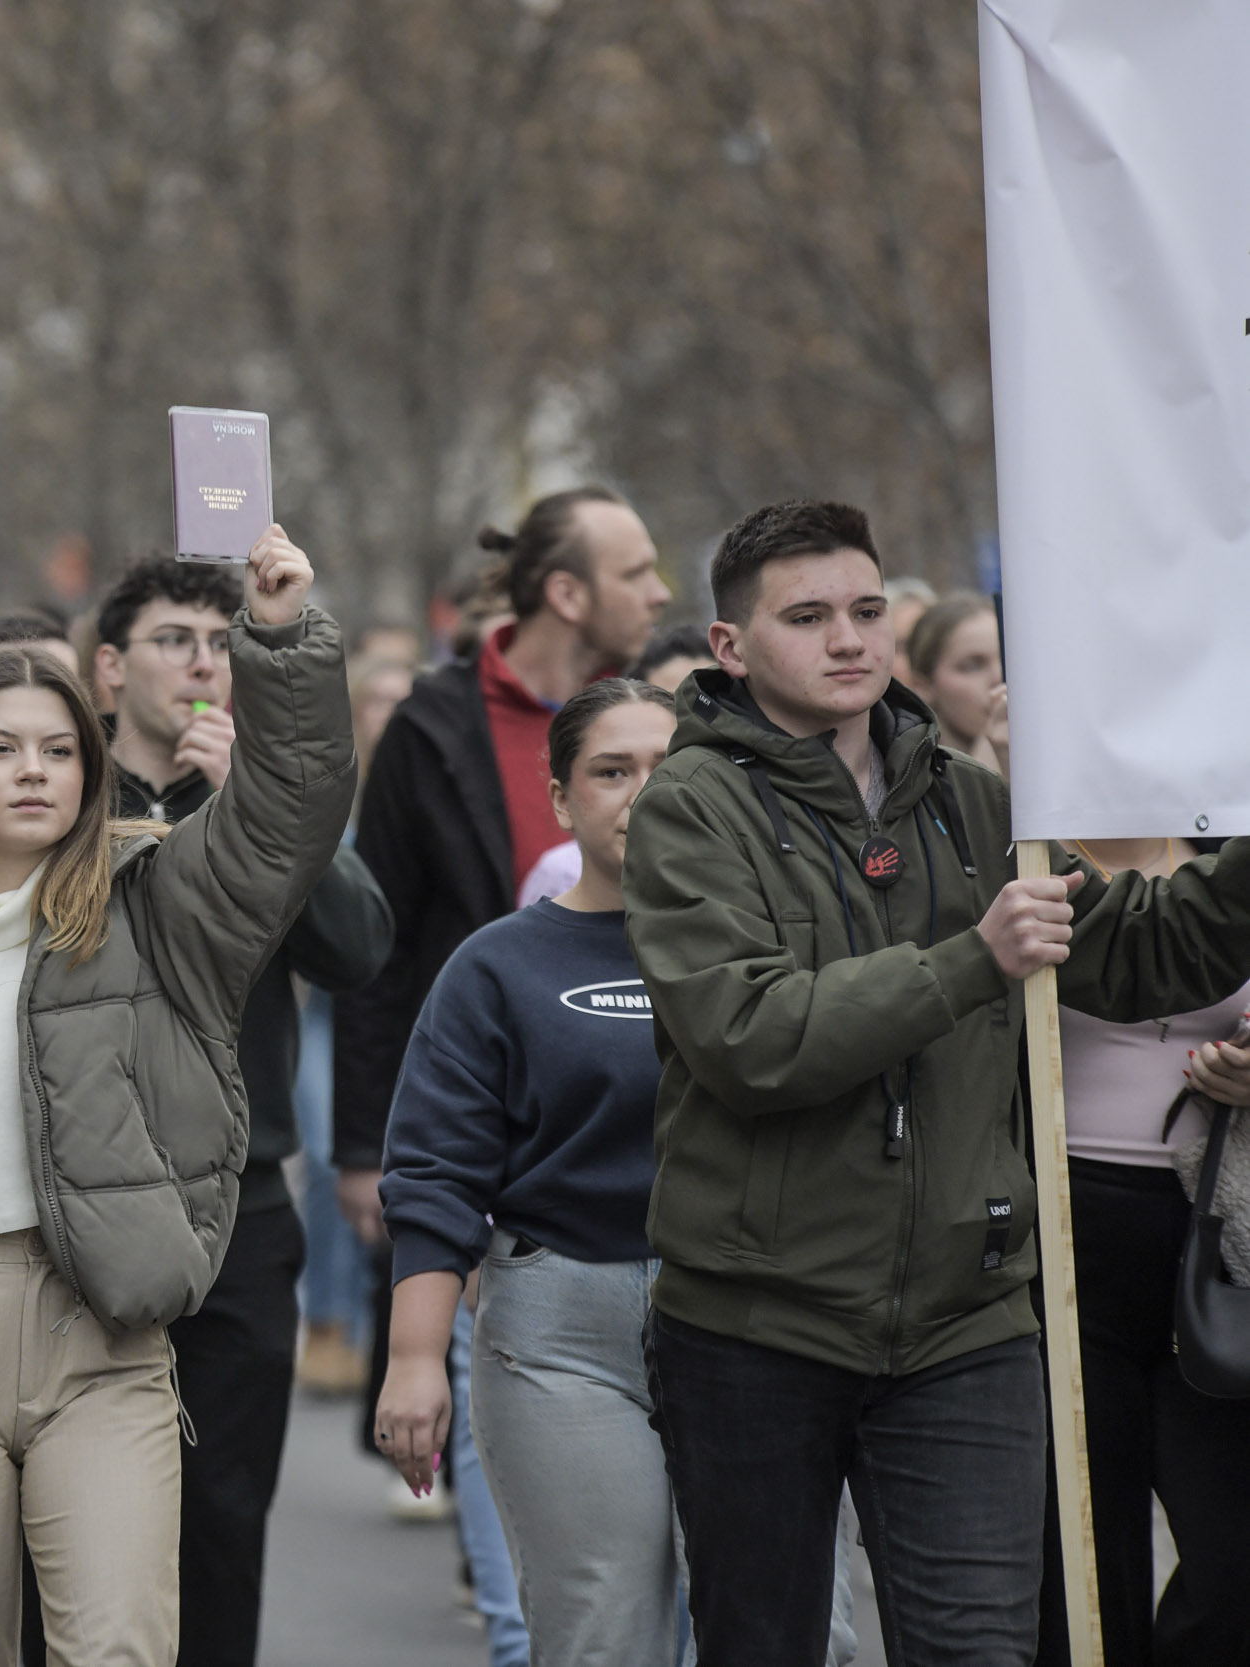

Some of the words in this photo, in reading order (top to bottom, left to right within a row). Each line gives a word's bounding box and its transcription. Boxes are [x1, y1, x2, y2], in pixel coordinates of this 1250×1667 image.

[212, 423, 256, 437] MODENA
[198, 486, 247, 497] СТУДЕНТСКА
[203, 494, 243, 504] КЊИЖИЦА
[208, 502, 239, 511] ИНДЕКС
